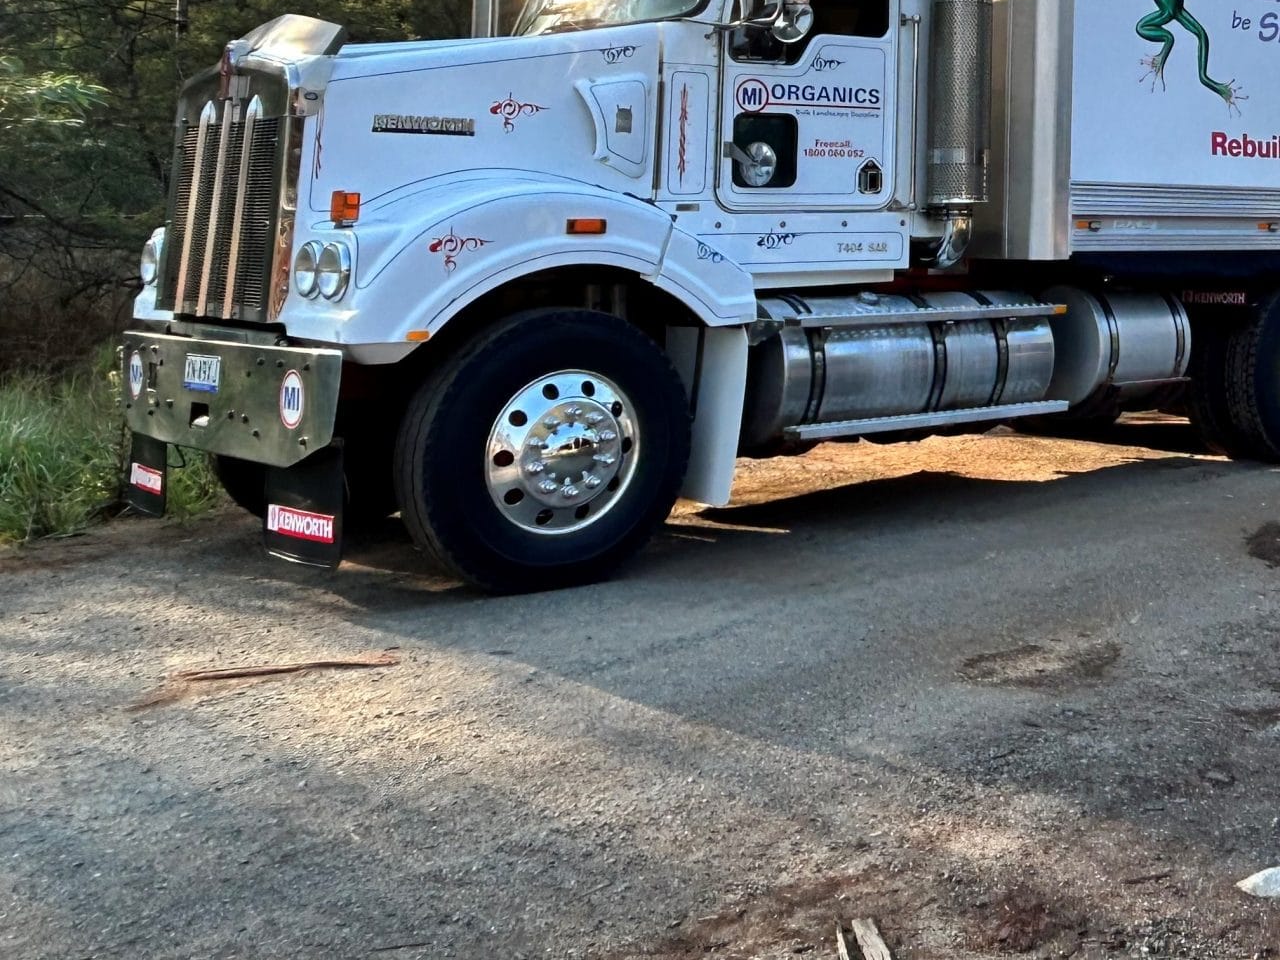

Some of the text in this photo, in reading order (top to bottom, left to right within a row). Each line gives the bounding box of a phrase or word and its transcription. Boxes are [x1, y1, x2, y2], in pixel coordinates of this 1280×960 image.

[1232, 10, 1251, 30] be
[742, 84, 880, 106] MI ORGANICS
[373, 114, 475, 135] KENWORTH
[804, 148, 826, 157] 1800
[283, 386, 300, 411] MI
[278, 510, 333, 539] KENWORTH
